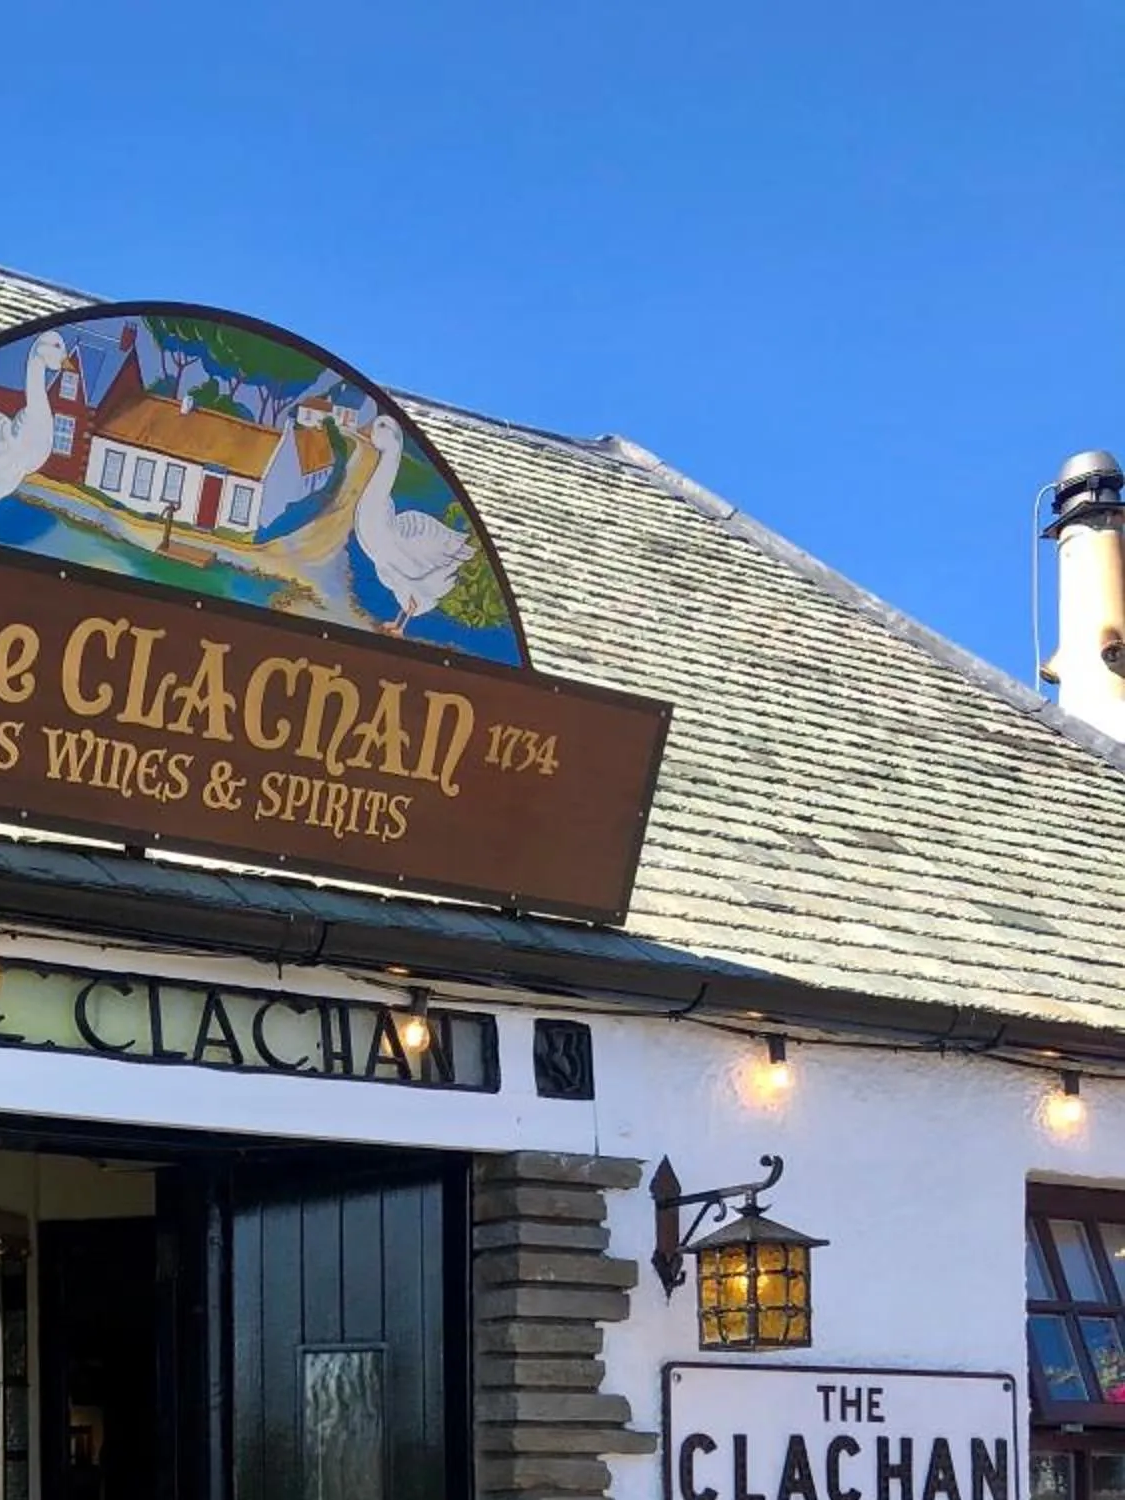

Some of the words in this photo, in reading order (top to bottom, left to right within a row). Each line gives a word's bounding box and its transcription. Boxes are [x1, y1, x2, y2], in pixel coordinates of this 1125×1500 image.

[62, 617, 476, 797] CLACHAN
[485, 723, 560, 775] 1734
[41, 726, 194, 803] WINES
[202, 760, 247, 810] &
[254, 770, 412, 843] SPIRITS
[74, 976, 455, 1083] CLACHAN
[816, 1385, 885, 1423] THE
